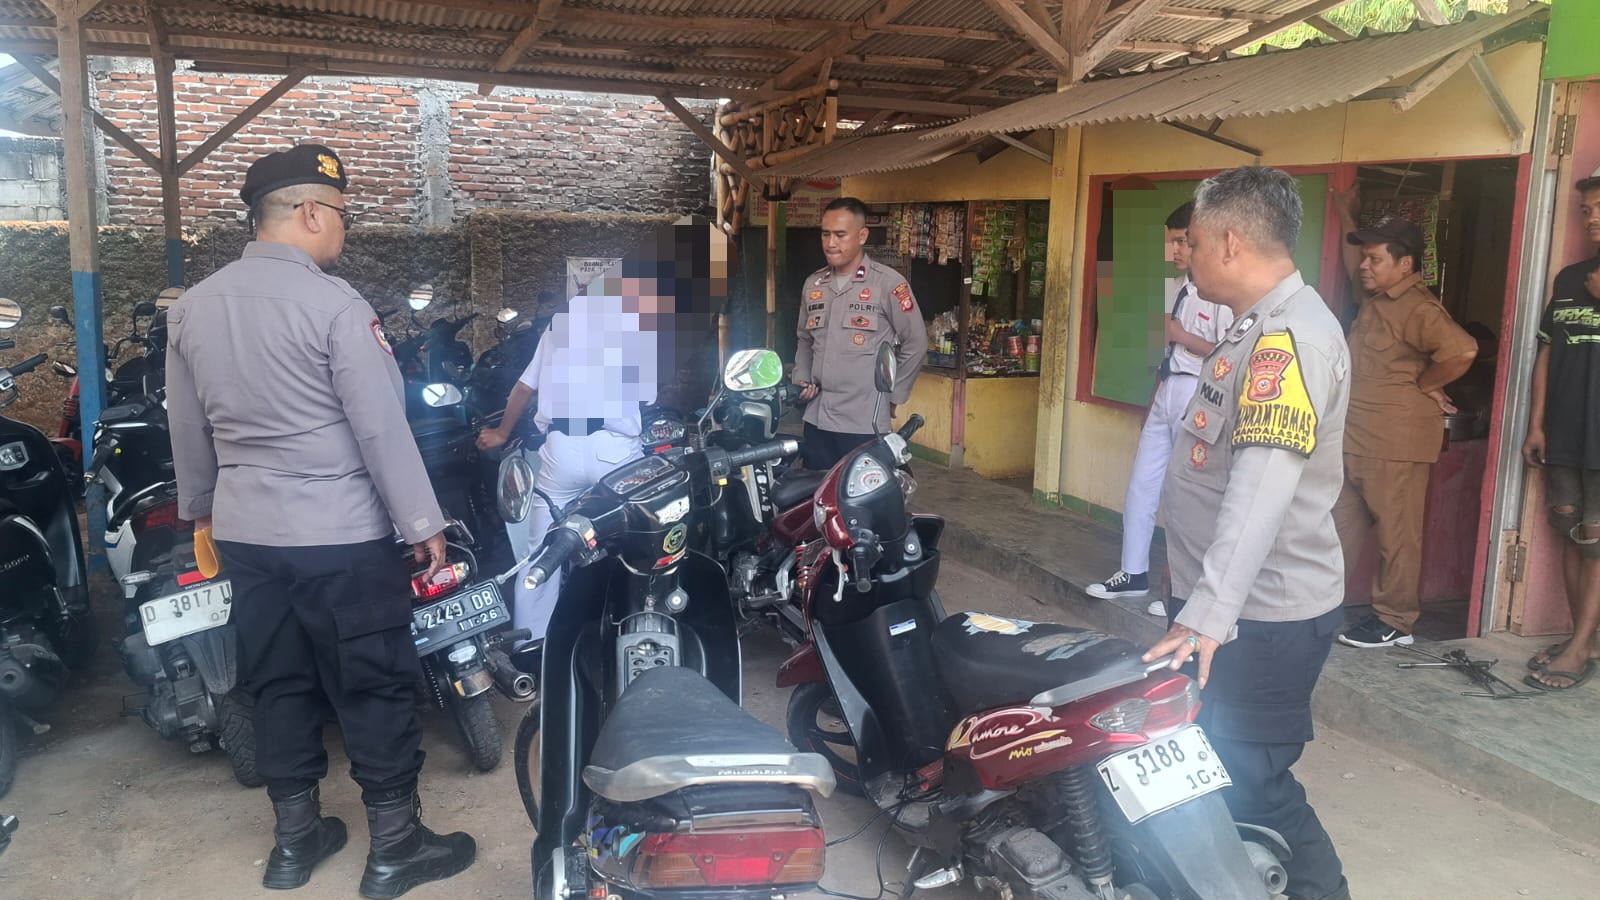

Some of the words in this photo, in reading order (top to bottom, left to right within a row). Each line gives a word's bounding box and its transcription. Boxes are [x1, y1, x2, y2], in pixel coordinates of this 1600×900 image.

[848, 303, 881, 312] POLRI
[1200, 382, 1225, 407] POLRI
[144, 606, 157, 622] D
[169, 589, 212, 614] 3817
[423, 602, 464, 629] 2449
[471, 590, 493, 610] DB
[1008, 746, 1034, 760] mio
[1101, 767, 1120, 792] Z
[1127, 739, 1185, 777] 3188
